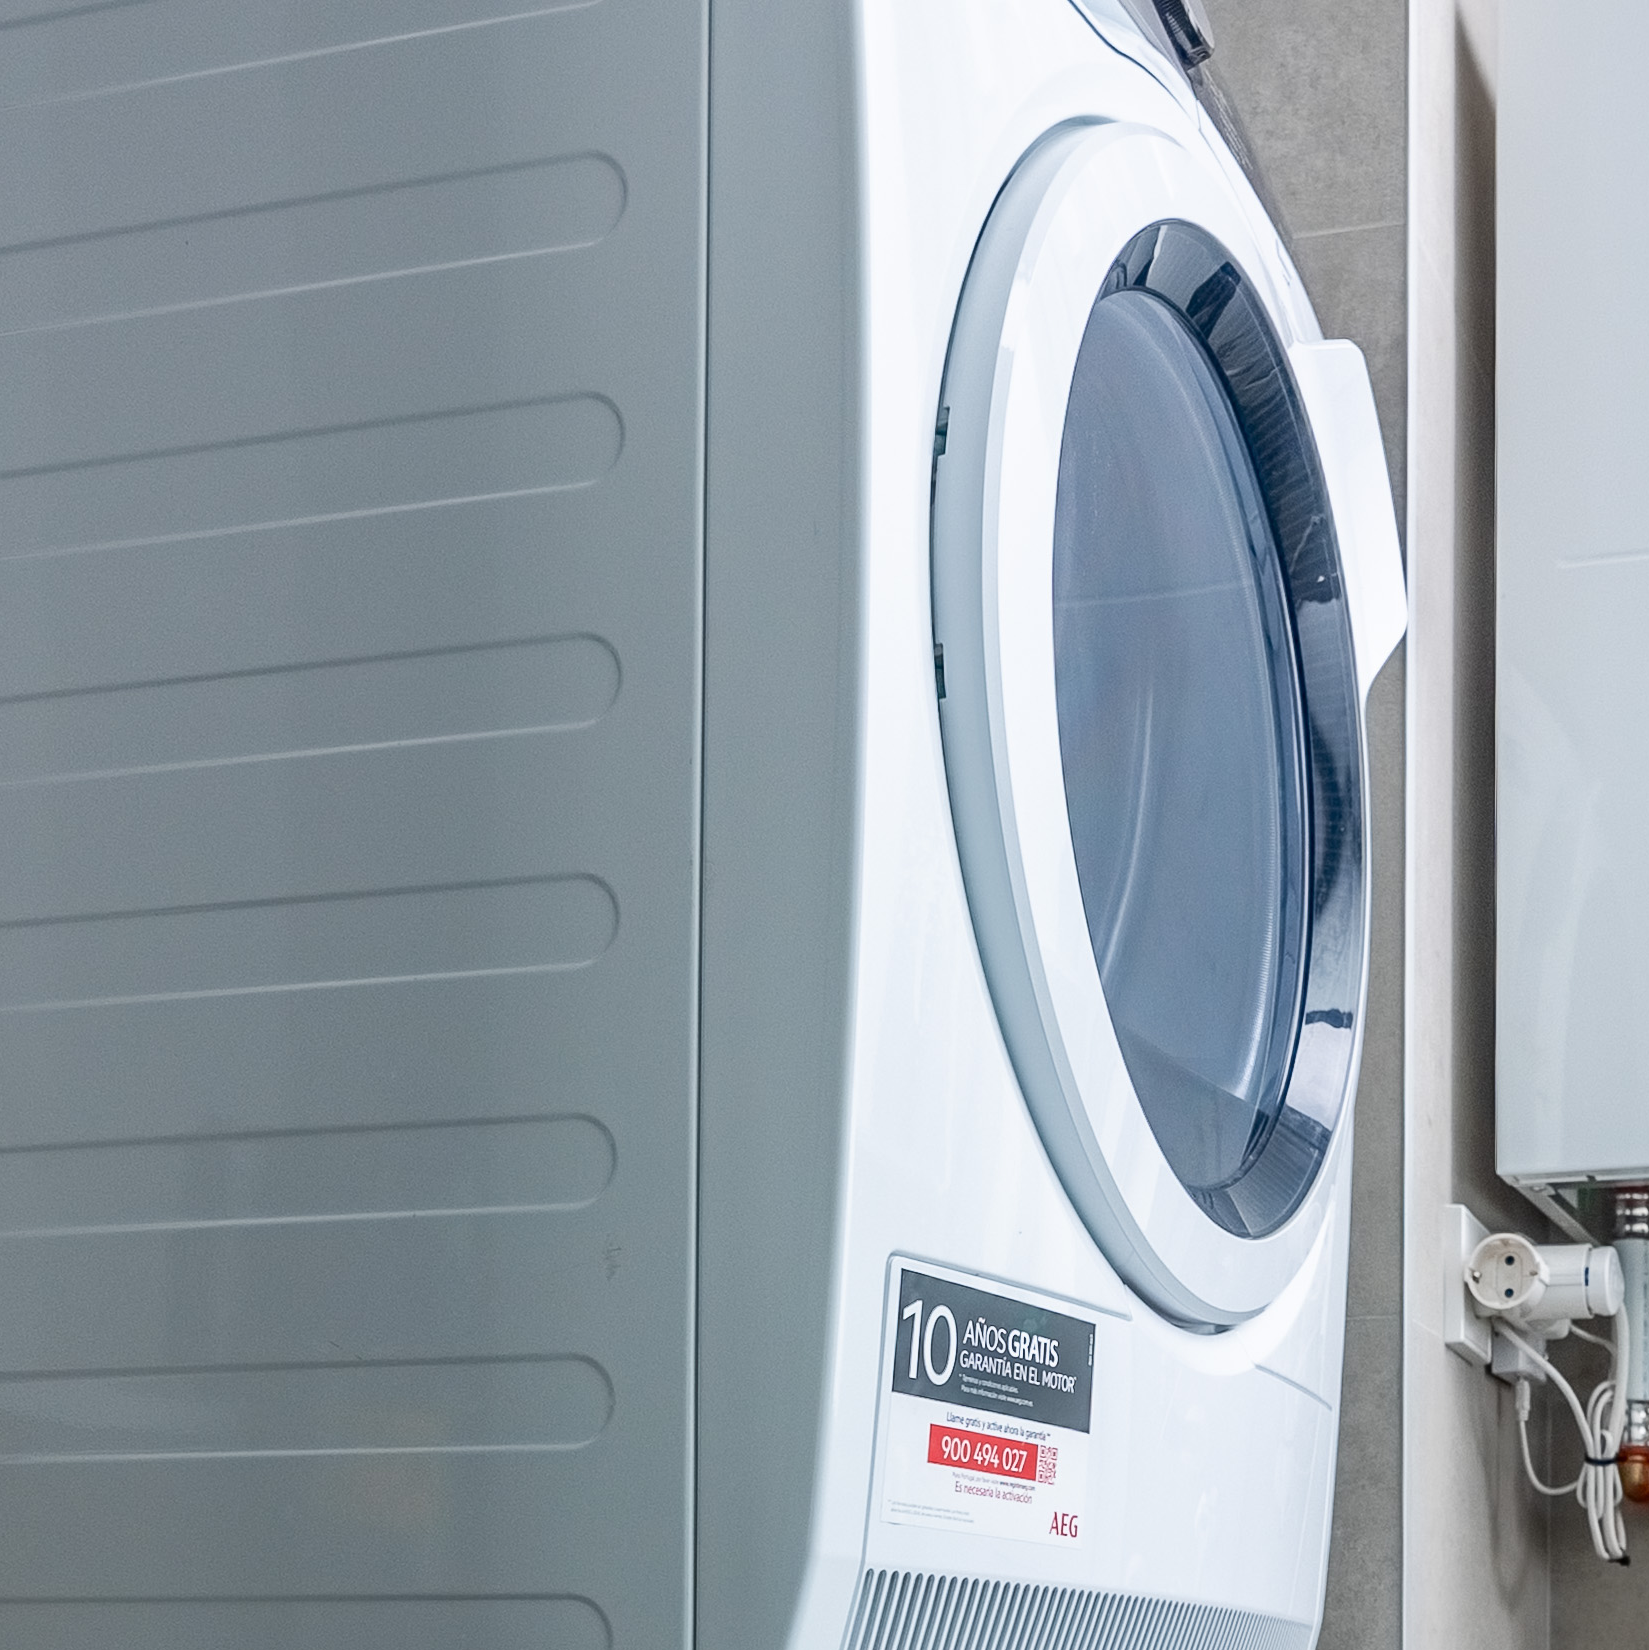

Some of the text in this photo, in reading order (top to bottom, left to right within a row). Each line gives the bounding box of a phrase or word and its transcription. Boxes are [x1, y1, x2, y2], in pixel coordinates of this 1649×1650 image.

[902, 1299, 958, 1386] 10
[962, 1316, 1007, 1355] AÑOS
[1008, 1329, 1060, 1368] GRATIS
[959, 1350, 1012, 1379] GARANTÍA
[1013, 1363, 1028, 1383] EN
[1028, 1367, 1041, 1386] EL
[965, 1415, 982, 1430] gratis
[941, 1435, 1028, 1473] 900 494 027
[1048, 1511, 1079, 1539] AEG
